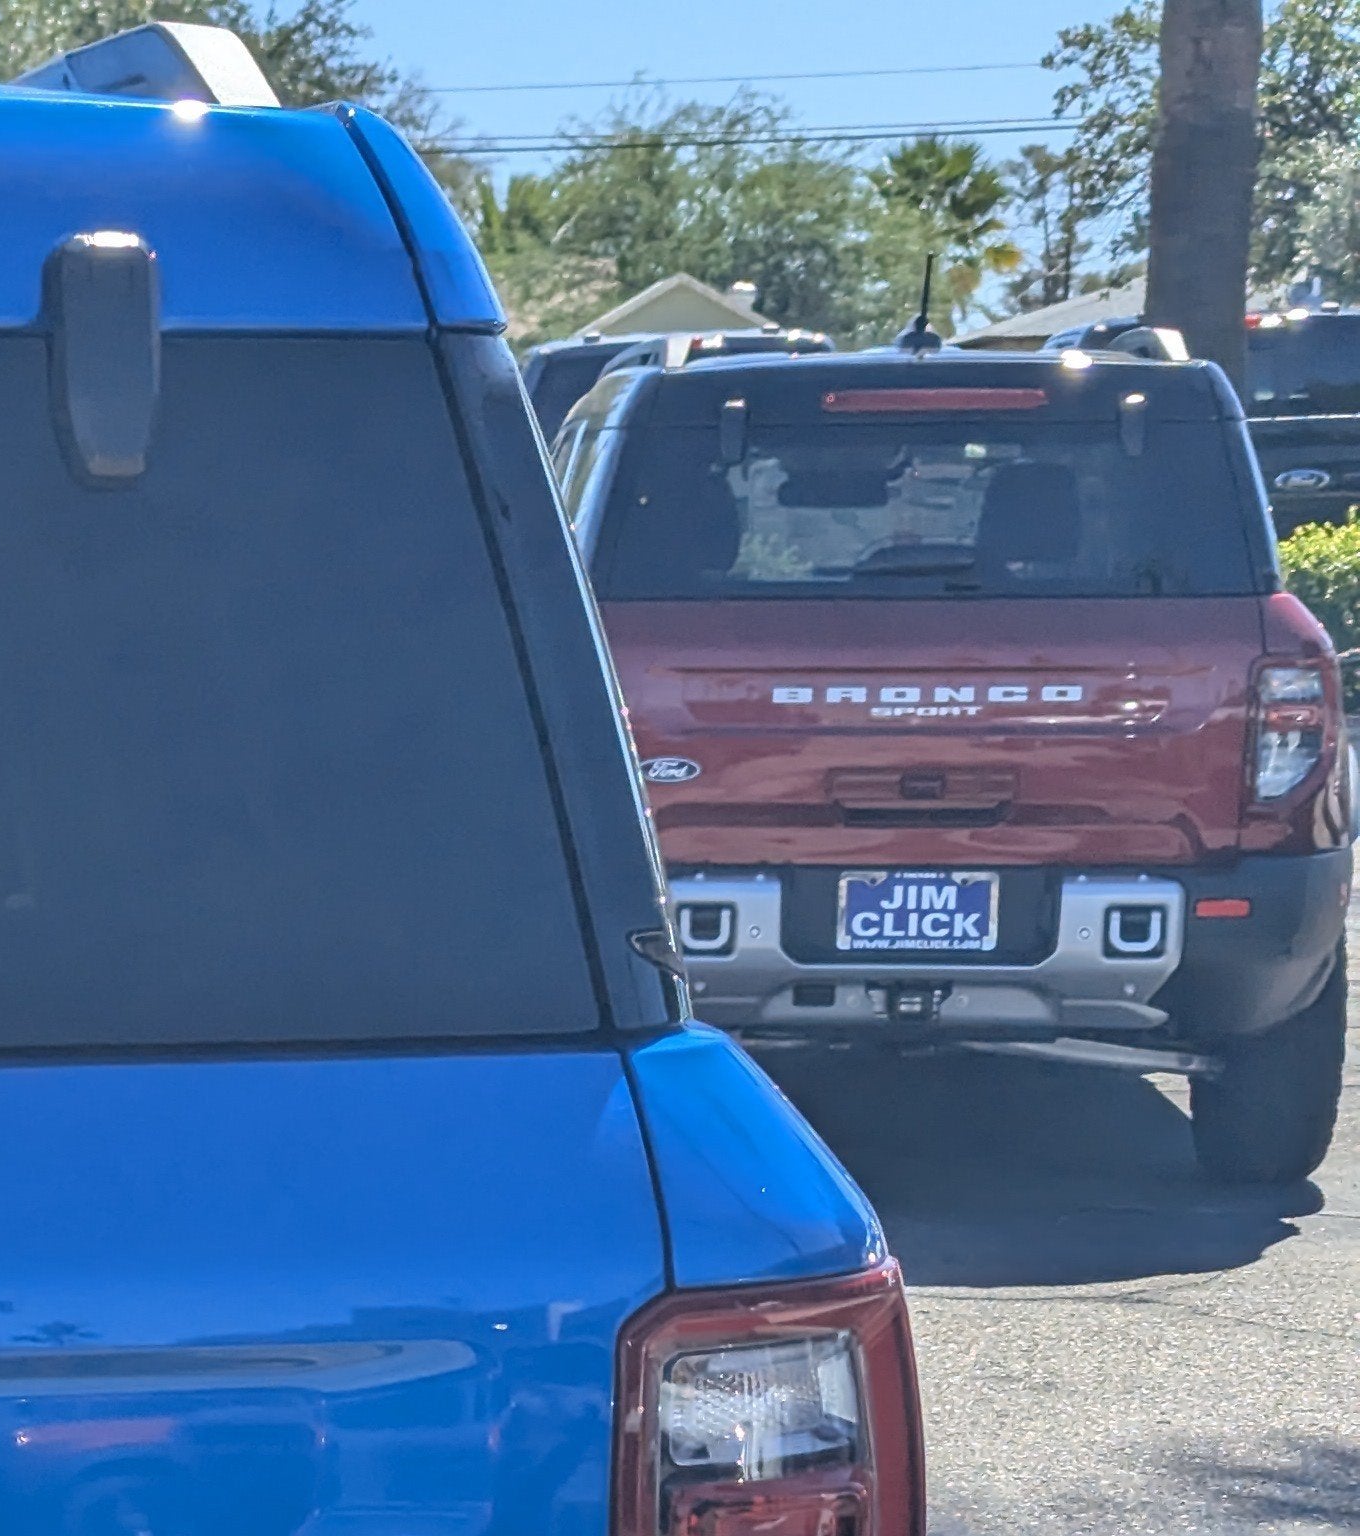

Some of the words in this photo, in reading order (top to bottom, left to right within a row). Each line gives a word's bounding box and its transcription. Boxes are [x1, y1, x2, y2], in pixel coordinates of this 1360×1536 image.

[772, 686, 1082, 703] BRONCO
[870, 706, 982, 718] SPORT
[648, 760, 688, 778] Ford
[880, 885, 958, 910] JIM
[851, 912, 981, 937] CLICK
